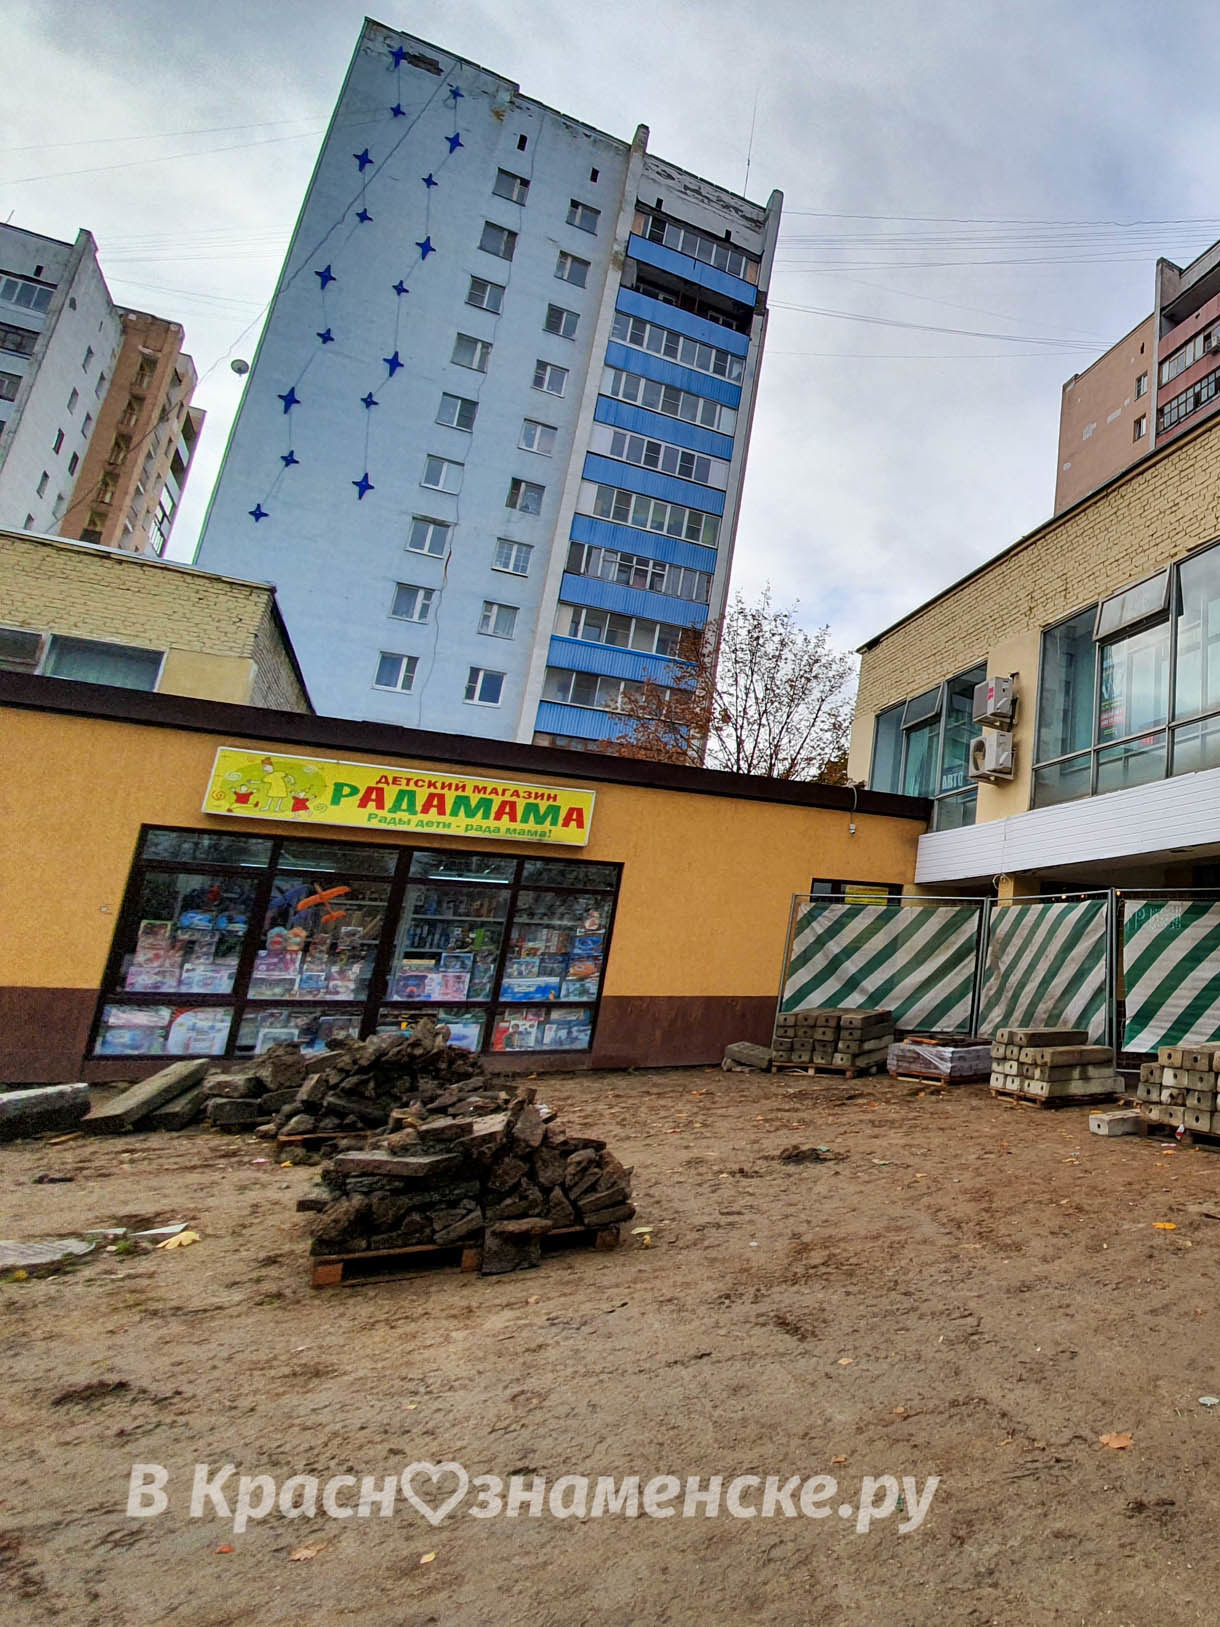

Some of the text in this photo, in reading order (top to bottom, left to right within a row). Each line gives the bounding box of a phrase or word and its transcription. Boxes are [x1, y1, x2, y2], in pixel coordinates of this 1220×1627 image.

[375, 774, 558, 802] ДЕТСКИЙ МАГАЗИН
[330, 782, 585, 829] РАДАМАМА
[367, 813, 411, 826] Рады
[415, 819, 452, 829] дети
[464, 823, 501, 834] рада
[505, 827, 553, 838] мама!
